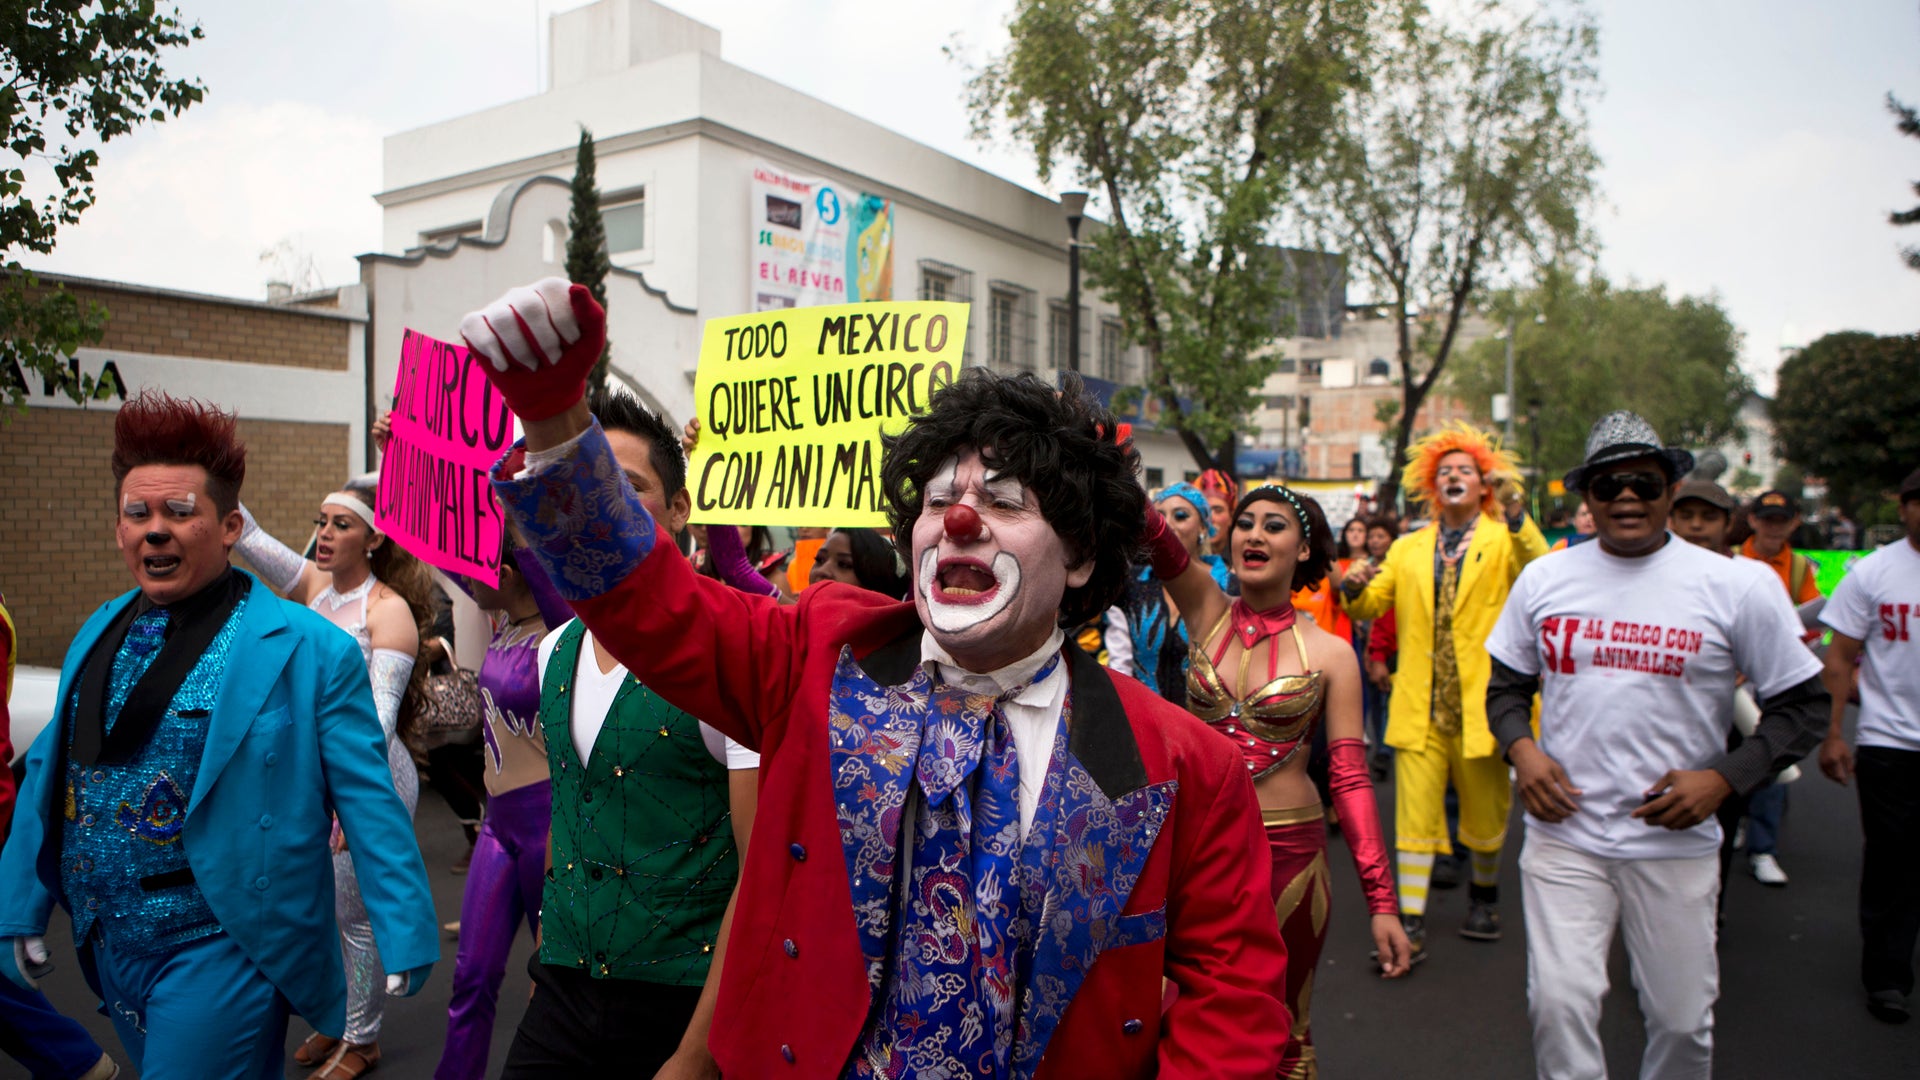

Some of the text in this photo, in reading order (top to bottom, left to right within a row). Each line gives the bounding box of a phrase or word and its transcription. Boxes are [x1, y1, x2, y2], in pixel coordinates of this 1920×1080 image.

[760, 262, 780, 282] EL
[725, 312, 948, 361] TODO MEXICO
[709, 361, 953, 441] QUIERE UN CIRCO
[380, 431, 407, 526] CON
[697, 451, 763, 511] CON
[1541, 616, 1580, 674] SI
[1583, 618, 1702, 654] AL CIRCO CON
[1880, 603, 1909, 641] SI
[1592, 646, 1685, 677] ANIMALES
